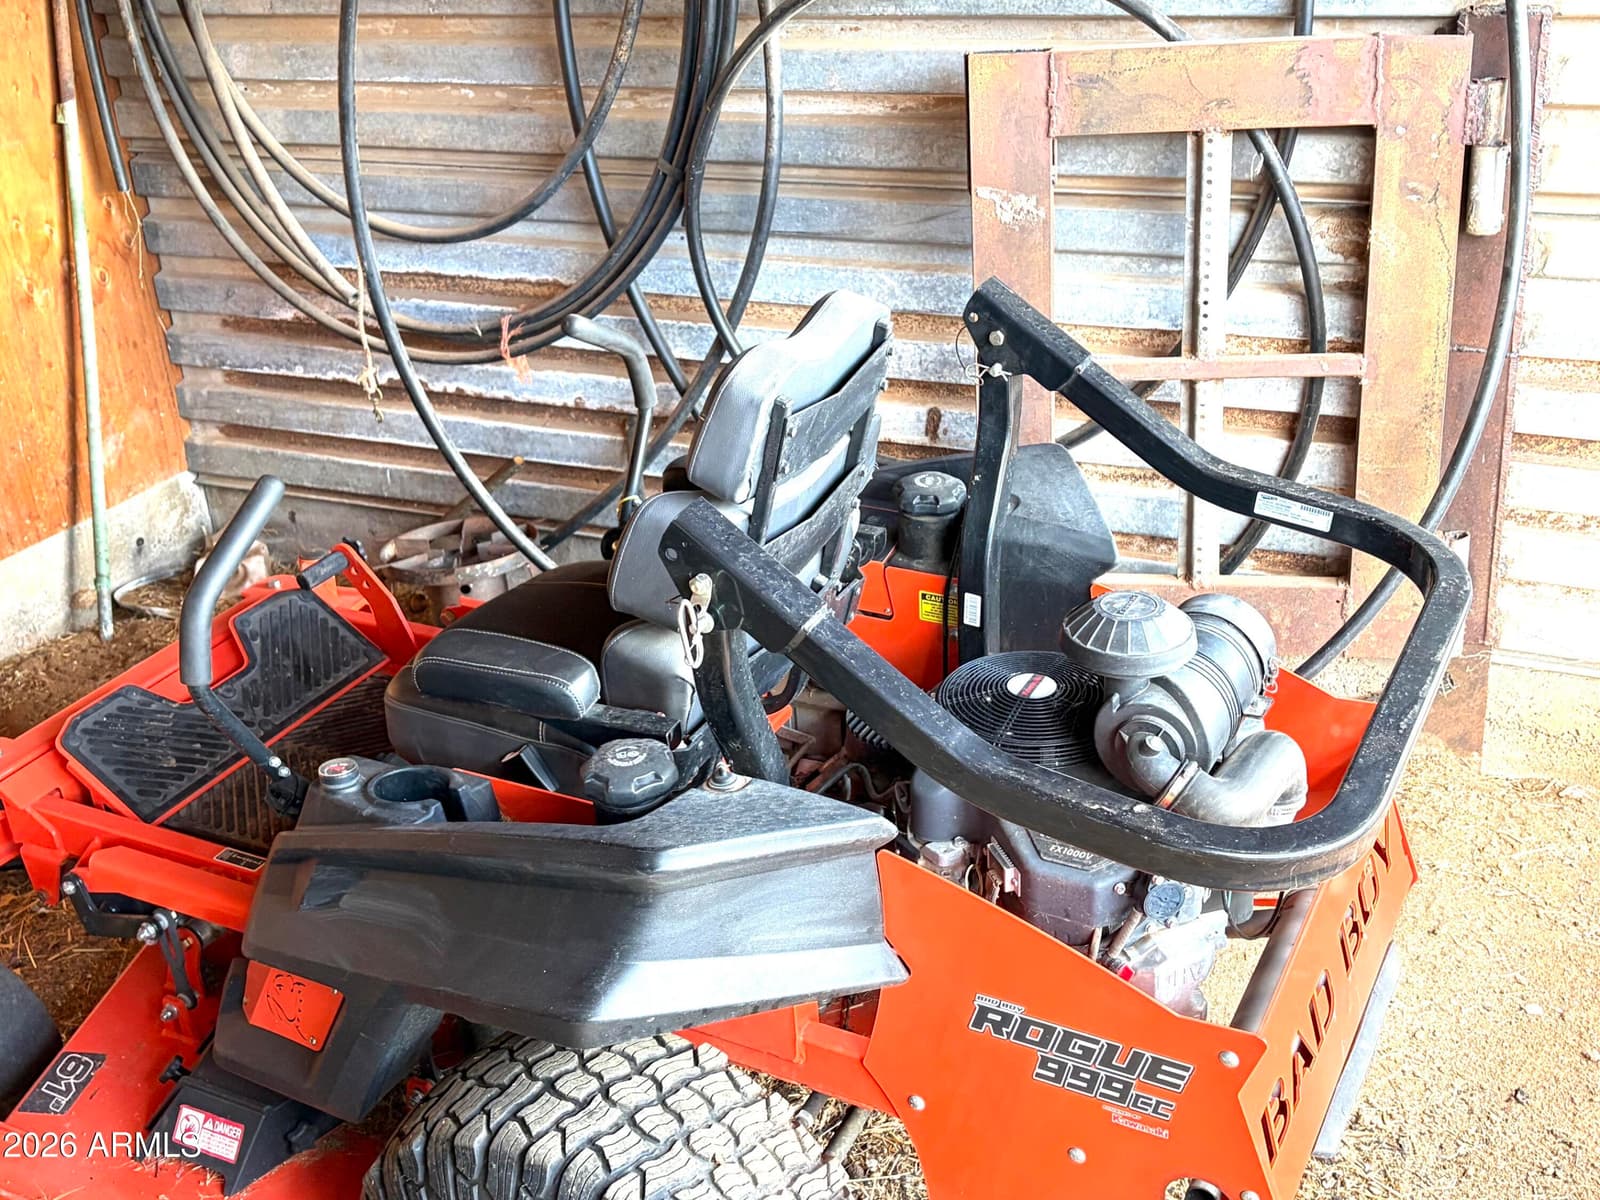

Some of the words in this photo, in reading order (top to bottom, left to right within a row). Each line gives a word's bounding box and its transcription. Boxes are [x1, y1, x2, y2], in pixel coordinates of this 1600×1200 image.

[1049, 845, 1094, 861] FX1000V
[969, 1003, 1195, 1093] ROGUE
[1261, 969, 1335, 1170] BAD
[213, 1120, 242, 1139] DANGER
